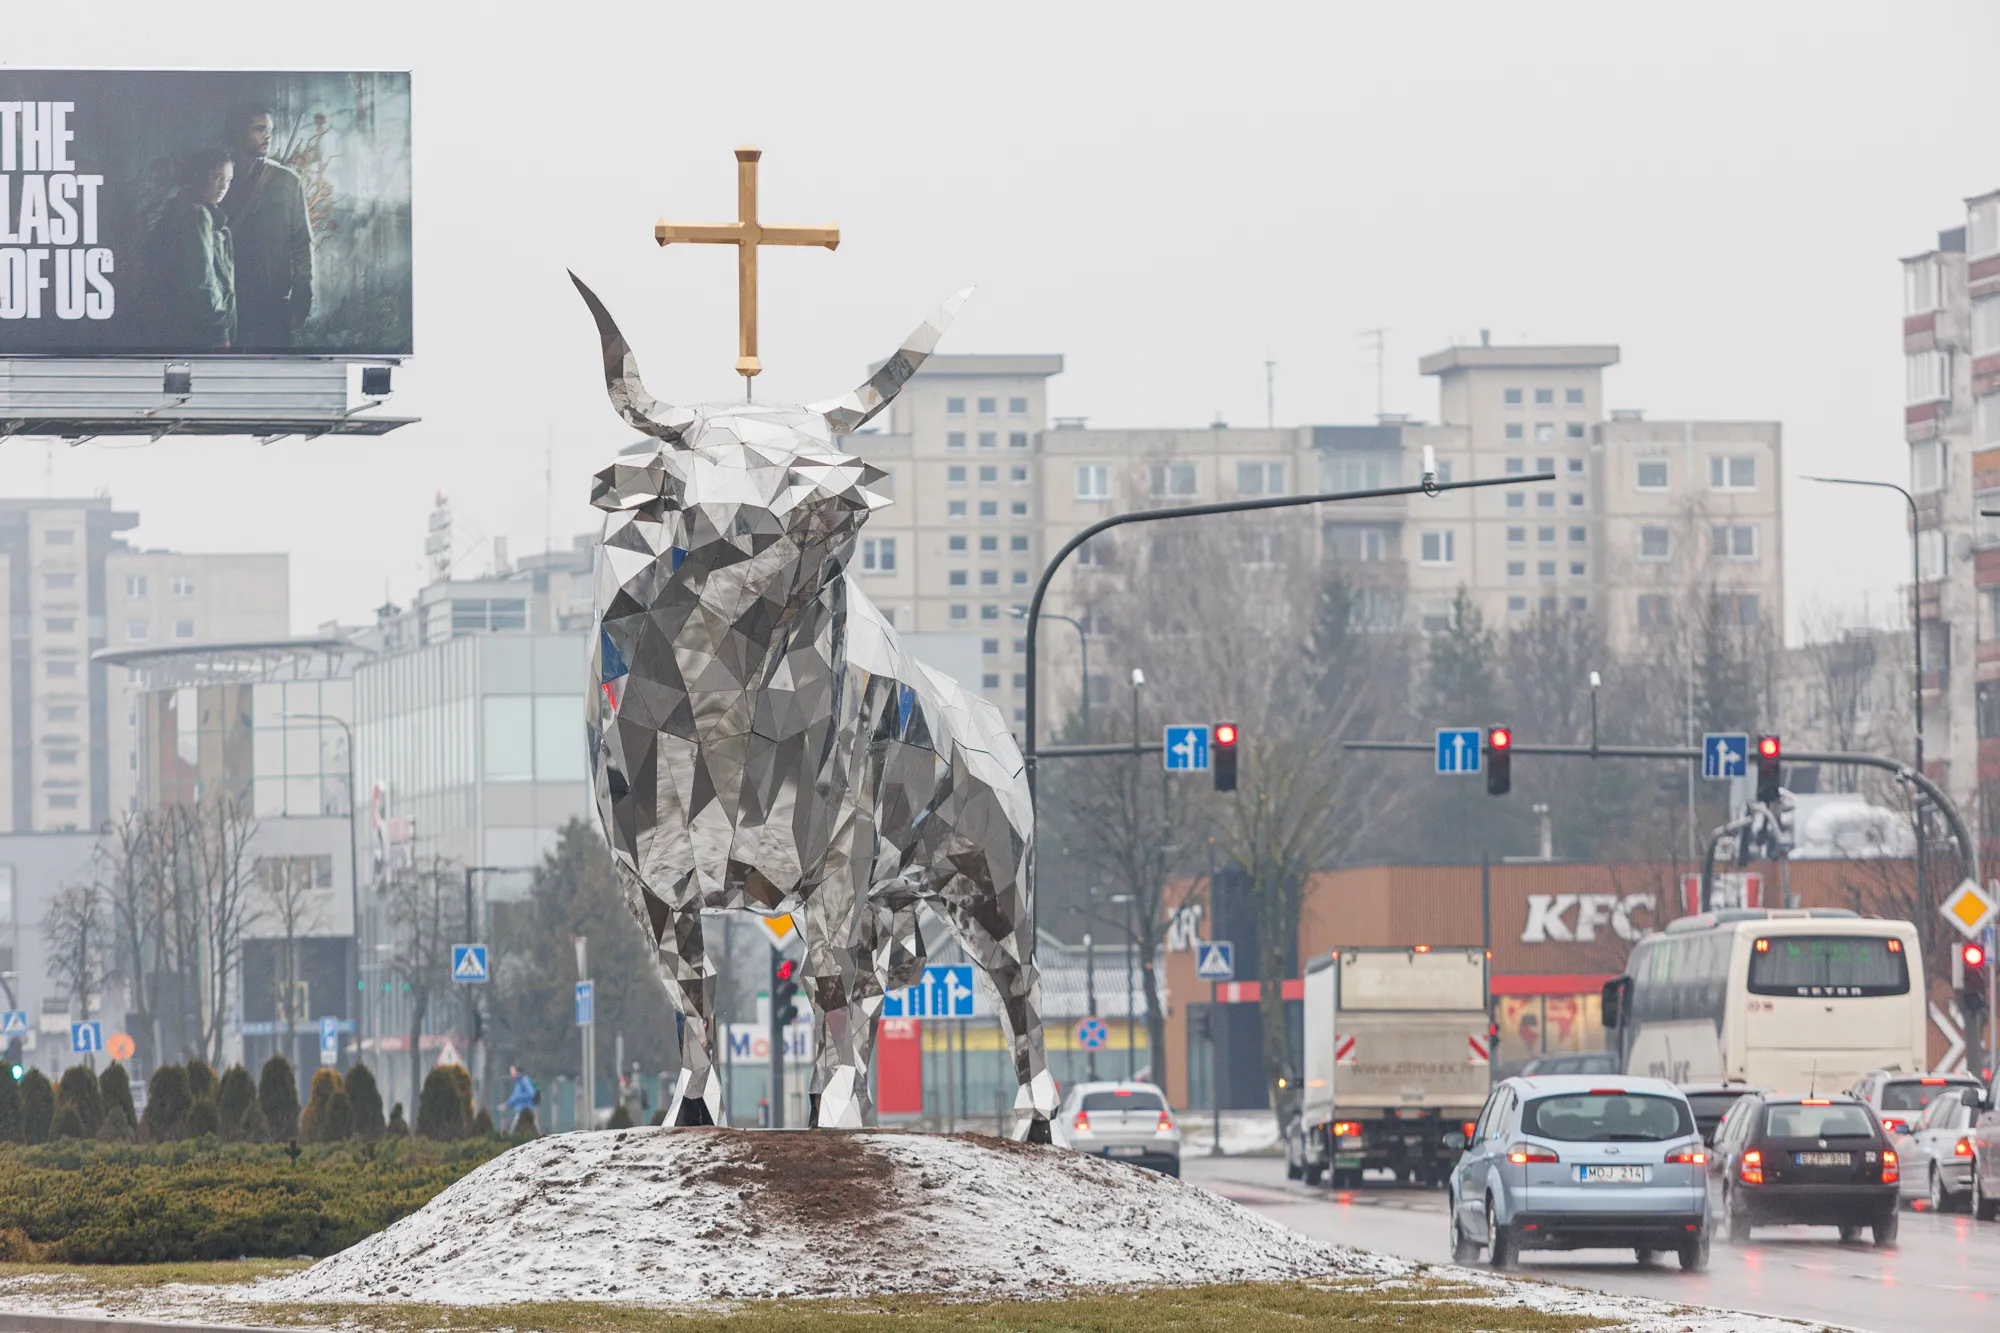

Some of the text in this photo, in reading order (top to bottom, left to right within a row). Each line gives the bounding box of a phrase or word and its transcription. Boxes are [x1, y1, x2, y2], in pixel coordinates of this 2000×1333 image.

[0, 101, 76, 171] THE
[0, 173, 104, 245] LAST
[0, 248, 115, 320] OF US
[1522, 894, 1656, 942] KFC
[1588, 1167, 1641, 1178] MDJ 214
